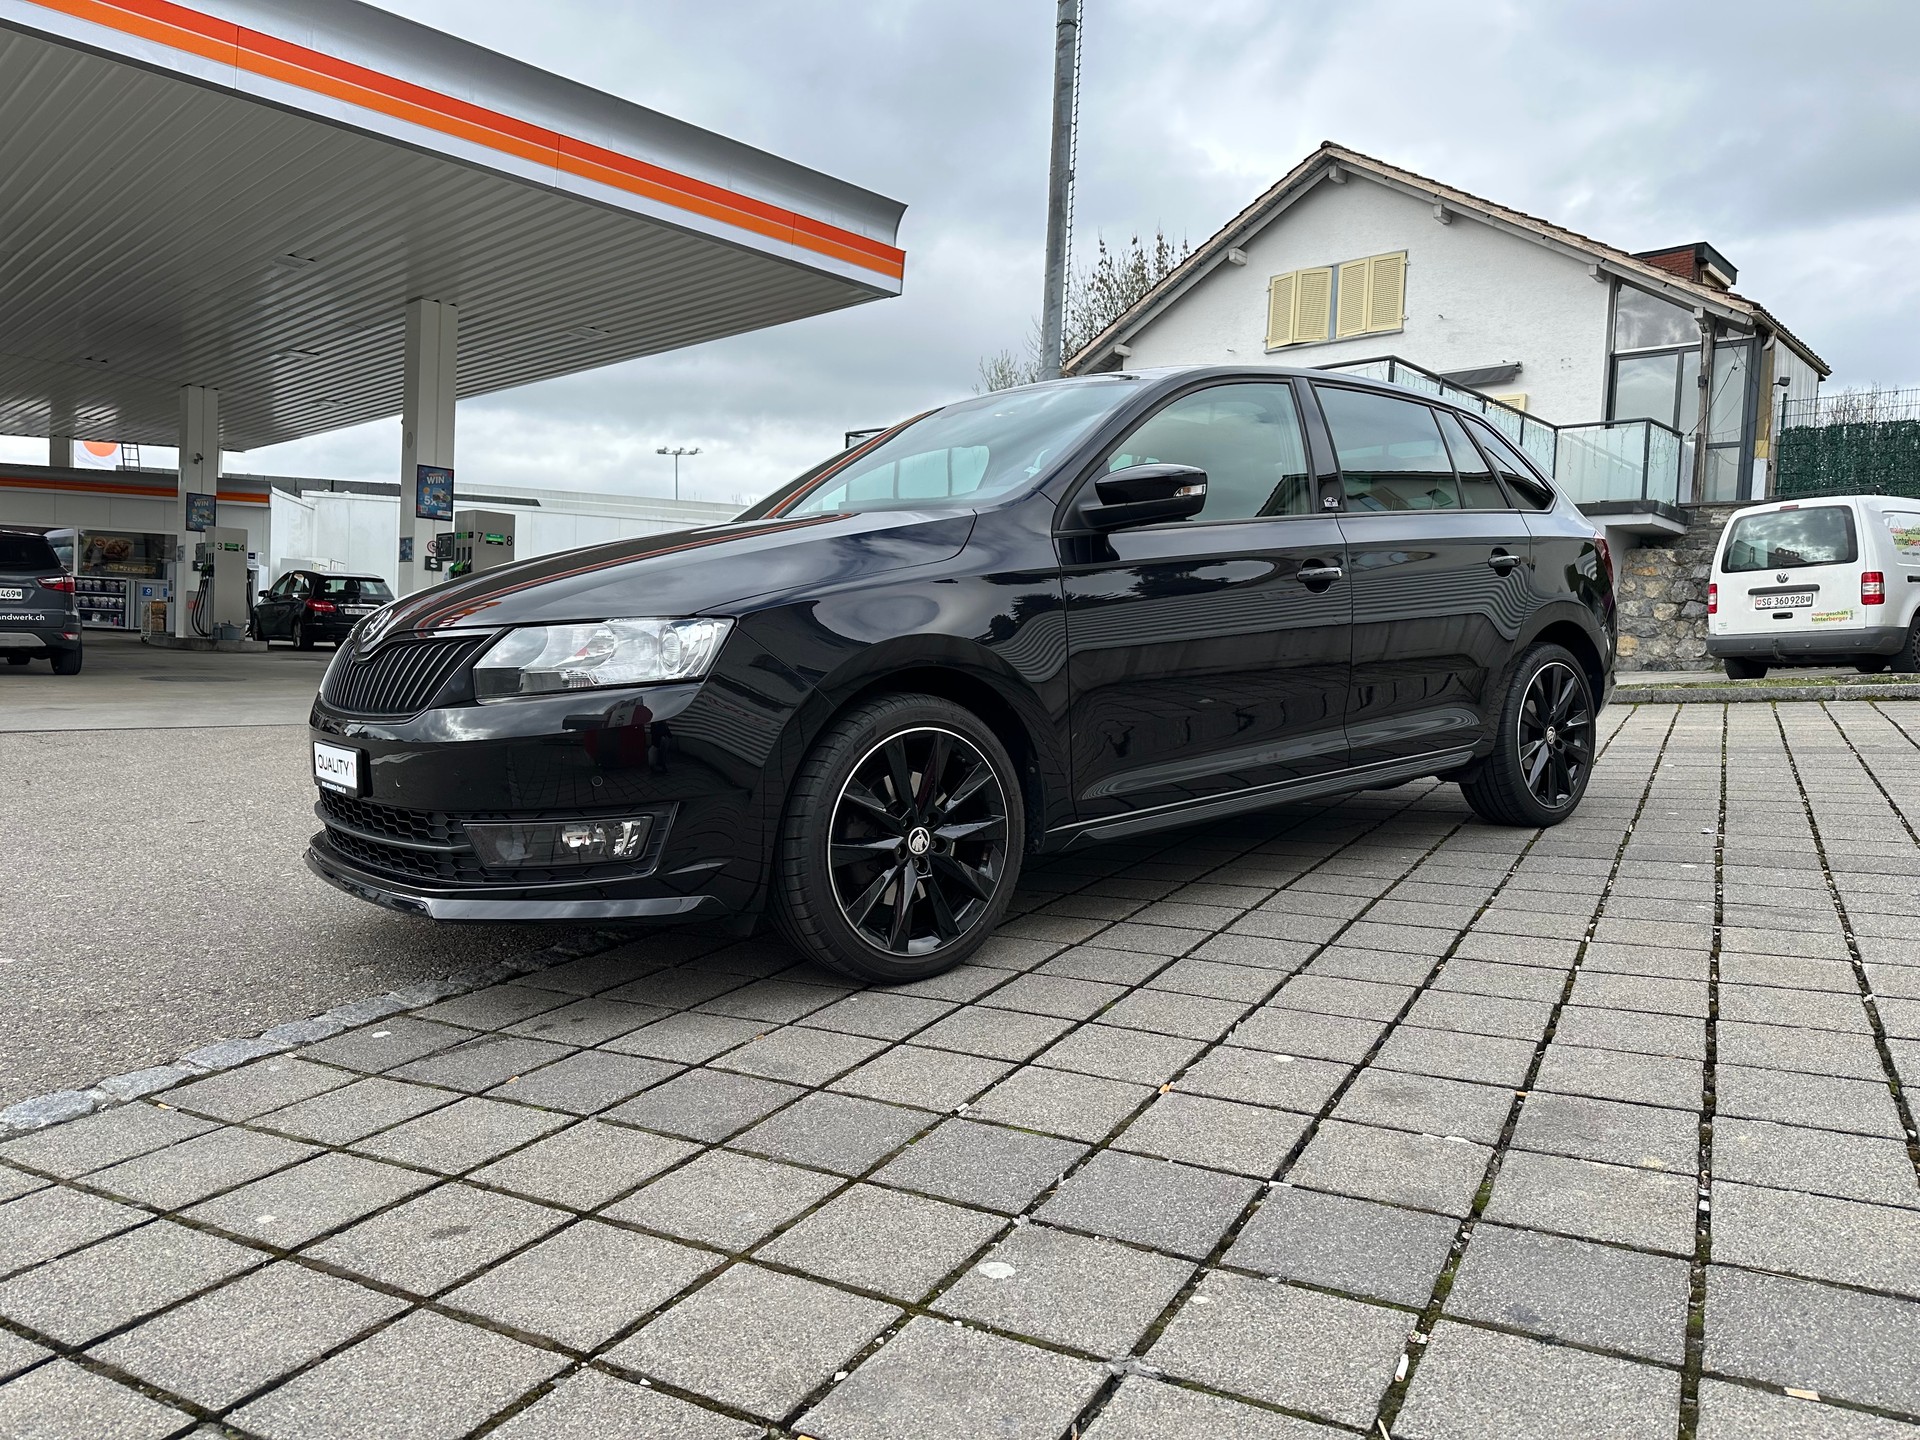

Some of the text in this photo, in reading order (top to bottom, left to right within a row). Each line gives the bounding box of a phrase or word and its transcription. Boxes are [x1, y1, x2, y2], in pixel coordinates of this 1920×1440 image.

[426, 476, 445, 484] WIN
[477, 531, 484, 542] 7
[506, 535, 513, 546] 8
[217, 542, 223, 551] 3
[239, 544, 245, 552] 4
[0, 590, 16, 598] 469
[1762, 595, 1806, 606] SG 360928
